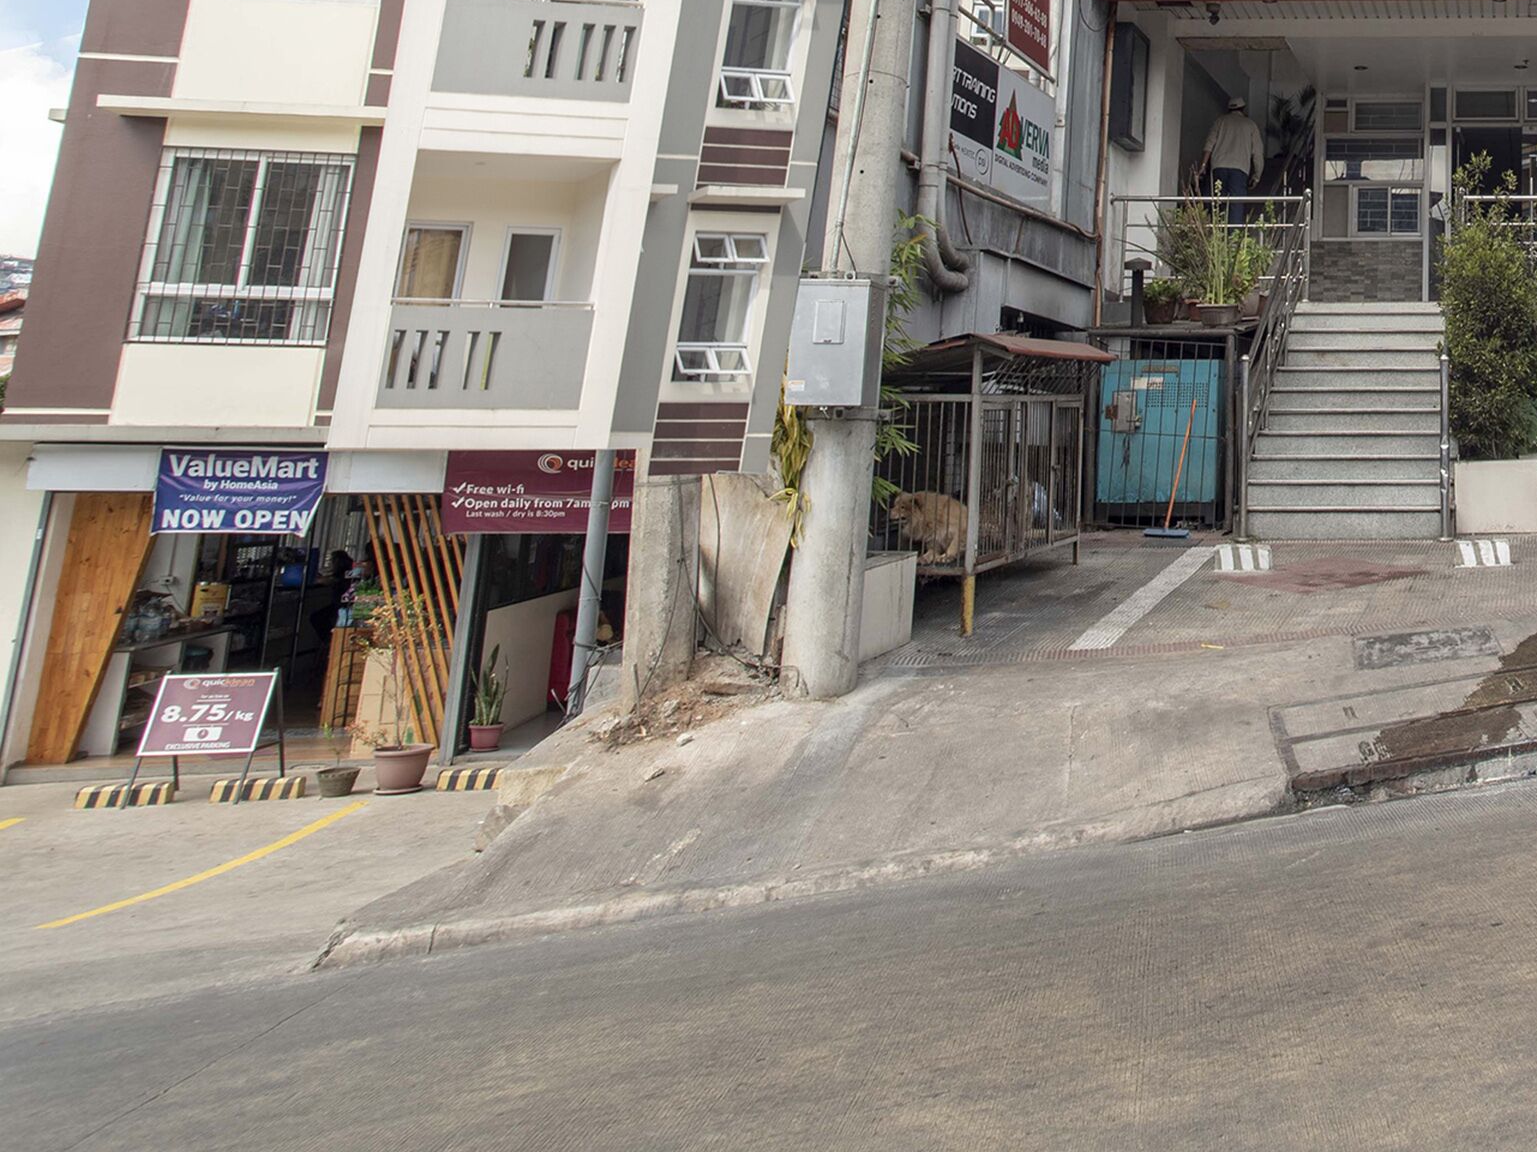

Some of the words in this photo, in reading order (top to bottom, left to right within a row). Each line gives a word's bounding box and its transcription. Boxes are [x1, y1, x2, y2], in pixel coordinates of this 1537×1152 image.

[961, 71, 997, 104] TRAINING
[168, 453, 319, 479] ValueMart
[203, 478, 219, 491] by
[219, 479, 279, 491] HomeAsia
[466, 483, 495, 495] Free
[496, 483, 525, 495] wi-fi
[213, 493, 228, 503] for
[230, 495, 252, 504] your
[464, 498, 499, 510] Open
[500, 497, 532, 510] daily
[533, 498, 563, 509] from
[566, 498, 592, 509] 7am
[160, 508, 226, 529] NOW
[234, 509, 310, 530] OPEN
[465, 510, 483, 518] Last
[484, 510, 505, 518] wash
[512, 510, 526, 519] dry
[527, 510, 534, 518] is
[535, 510, 566, 519] 8:30pm
[234, 710, 256, 722] kg
